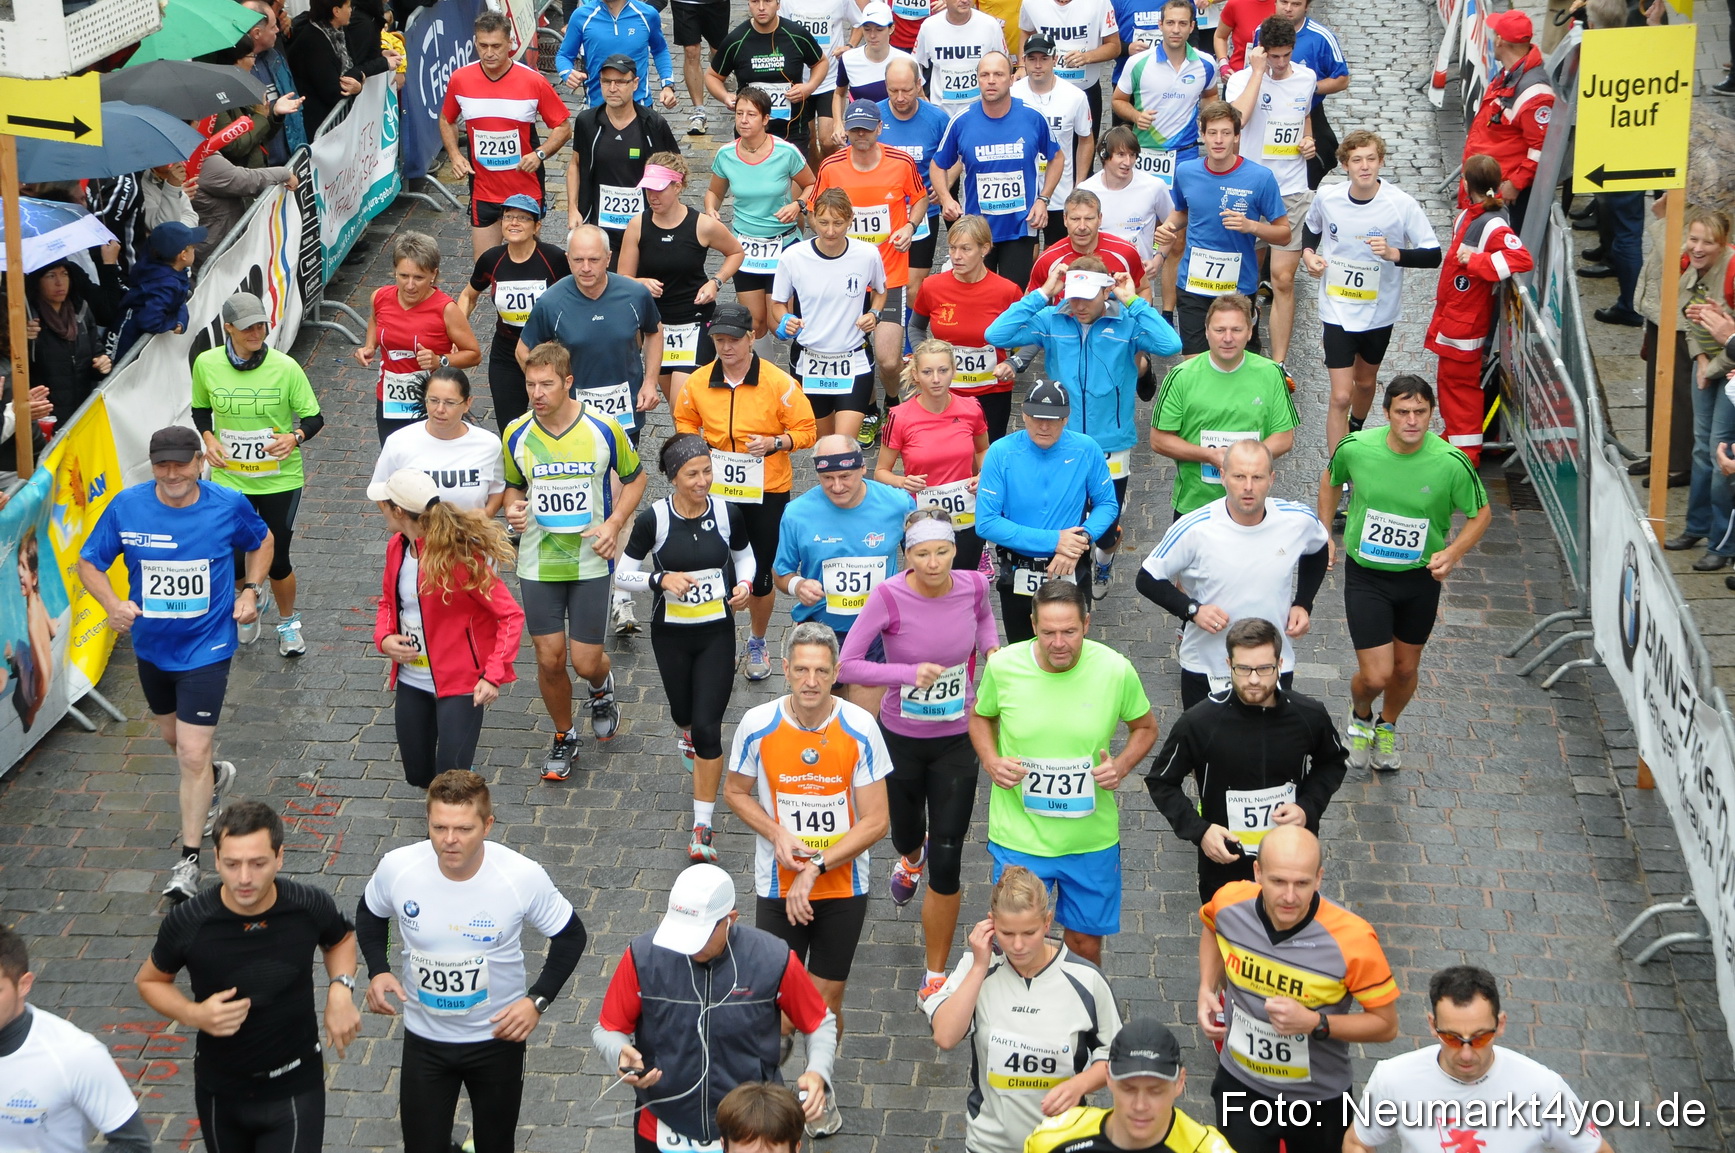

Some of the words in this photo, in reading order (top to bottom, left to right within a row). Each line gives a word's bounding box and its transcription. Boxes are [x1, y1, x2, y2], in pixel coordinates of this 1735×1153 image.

[1040, 25, 1088, 41] THULE
[934, 45, 982, 60] THULE
[430, 43, 473, 105] Fische
[945, 74, 978, 90] 2428
[1583, 70, 1689, 102] Jugend-
[1162, 92, 1186, 100] Stefan
[1611, 102, 1659, 128] lauf
[1274, 128, 1300, 144] 567
[479, 139, 517, 156] 2249
[974, 143, 1024, 156] HUBER
[486, 158, 511, 166] Michael
[1135, 157, 1171, 174] 3090
[982, 182, 1021, 200] 2769
[604, 196, 640, 214] 2232
[988, 200, 1016, 209] Bernhard
[741, 241, 779, 258] 2817
[747, 260, 768, 268] Andrea
[1205, 261, 1226, 279] 77
[1331, 260, 1346, 268] PARTL
[1344, 270, 1364, 287] 76
[506, 292, 536, 309] 201
[1340, 290, 1362, 299] Jannik
[666, 334, 683, 348] 41
[670, 352, 680, 360] Eva
[956, 355, 986, 371] 264
[808, 360, 851, 376] 2710
[819, 380, 839, 388] Beate
[962, 374, 977, 382] Rita
[231, 442, 266, 460] 278
[240, 463, 260, 471] Petra
[532, 461, 596, 478] BOCK
[724, 464, 746, 484] 95
[422, 469, 480, 488] HULE
[552, 483, 580, 491] Neumarkt
[724, 487, 744, 496] Petra
[937, 486, 963, 496] Neumarkt
[537, 491, 587, 512] 3062
[1366, 513, 1387, 523] PARTL
[1388, 519, 1418, 529] Neumarkt
[1368, 523, 1420, 548] 2853
[1370, 547, 1409, 559] Johannes
[150, 574, 204, 597] 2390
[835, 571, 872, 593] 351
[166, 602, 187, 610] Willi
[842, 597, 865, 607] Georg
[922, 706, 946, 716] Sissy
[1022, 761, 1044, 771] PARTL
[778, 772, 843, 785] SportScheck
[1028, 771, 1087, 795] 2737
[778, 798, 800, 808] PARTL
[1048, 800, 1068, 810] Uwe
[1228, 795, 1253, 804] PARTL
[1254, 791, 1287, 804] Neumarkt
[790, 810, 836, 833] 149
[411, 954, 434, 966] PARTL
[435, 960, 473, 968] Neumarkt
[418, 967, 480, 993] 2937
[436, 998, 466, 1008] Claus
[1011, 1005, 1041, 1015] saller
[1234, 1011, 1253, 1031] PARTL
[991, 1036, 1019, 1049] PARTL
[1020, 1043, 1059, 1056] Neumarkt
[1246, 1032, 1291, 1063] 136
[1004, 1052, 1057, 1074] 469
[1246, 1060, 1289, 1076] Stephan
[1008, 1078, 1049, 1088] Claudia
